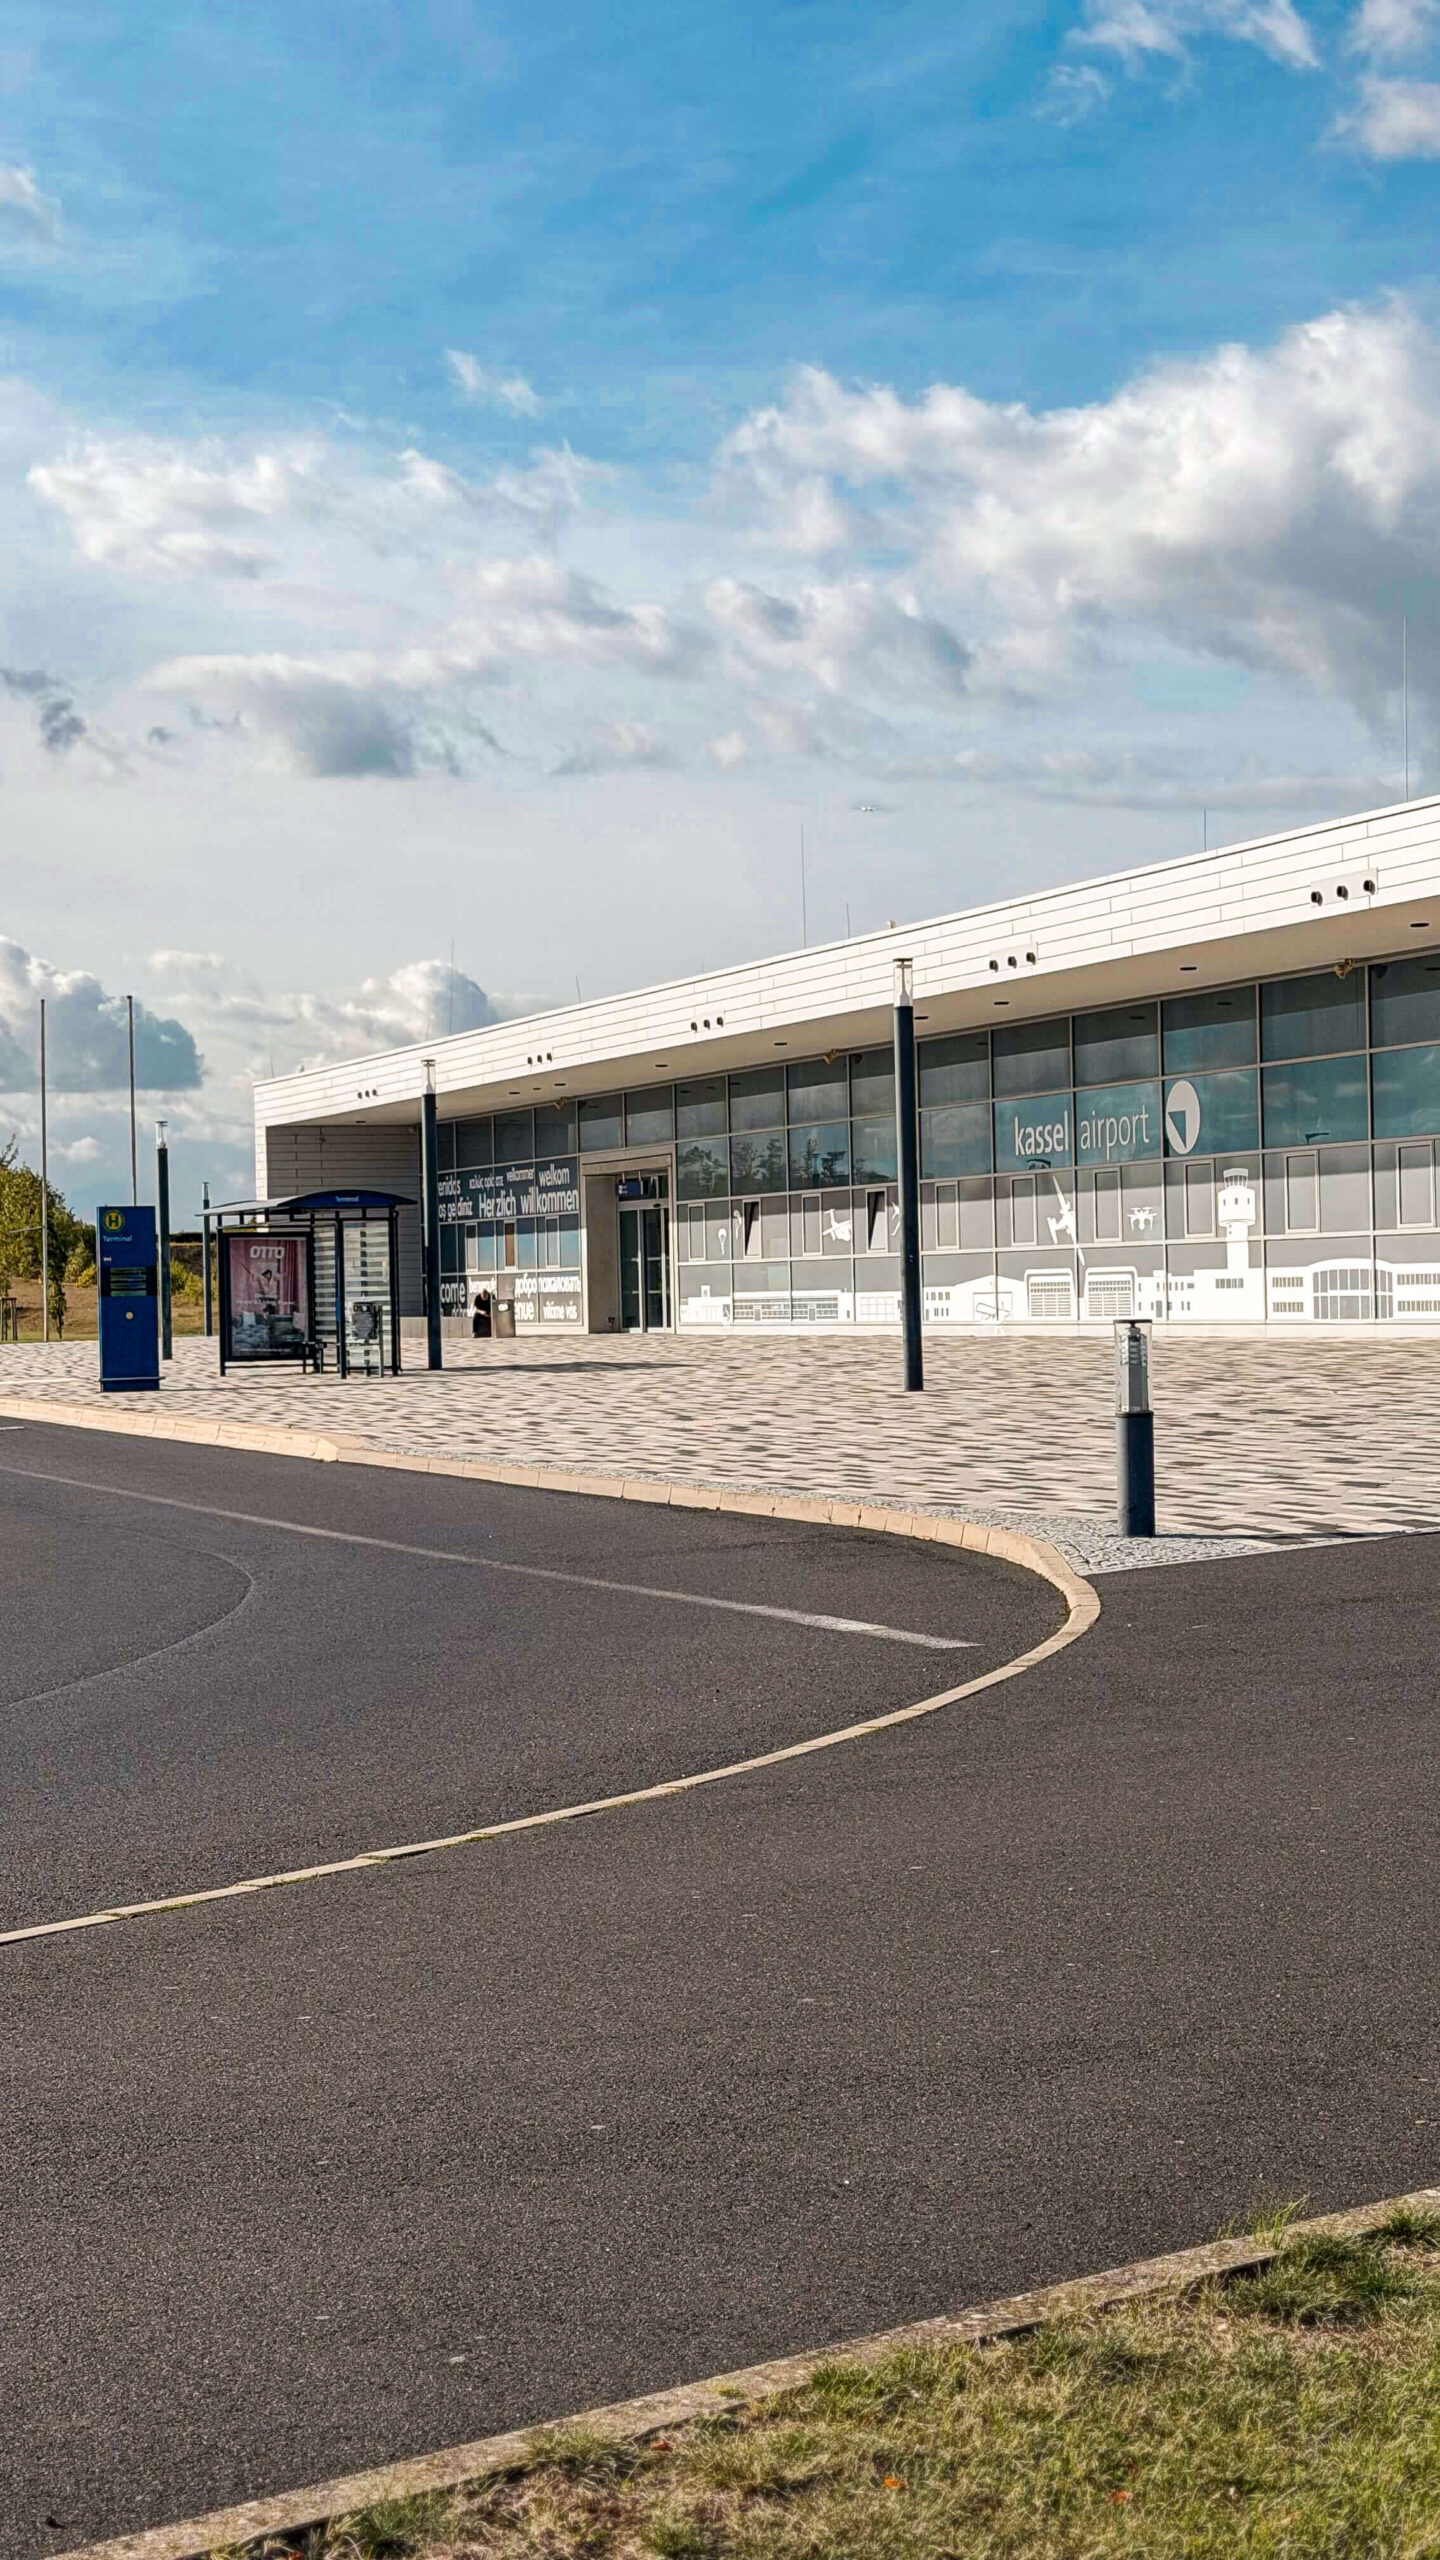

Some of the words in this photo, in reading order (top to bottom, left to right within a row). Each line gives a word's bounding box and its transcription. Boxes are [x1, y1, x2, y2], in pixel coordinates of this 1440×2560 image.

[1014, 1110, 1068, 1156] kassel
[1080, 1105, 1150, 1160] airport
[438, 1174, 461, 1197] enidos
[538, 1163, 570, 1188] welkom
[479, 1189, 517, 1219] Herzlich
[520, 1186, 579, 1216] willkommen
[102, 1234, 133, 1242] Terminal
[250, 1245, 285, 1259] OTTO
